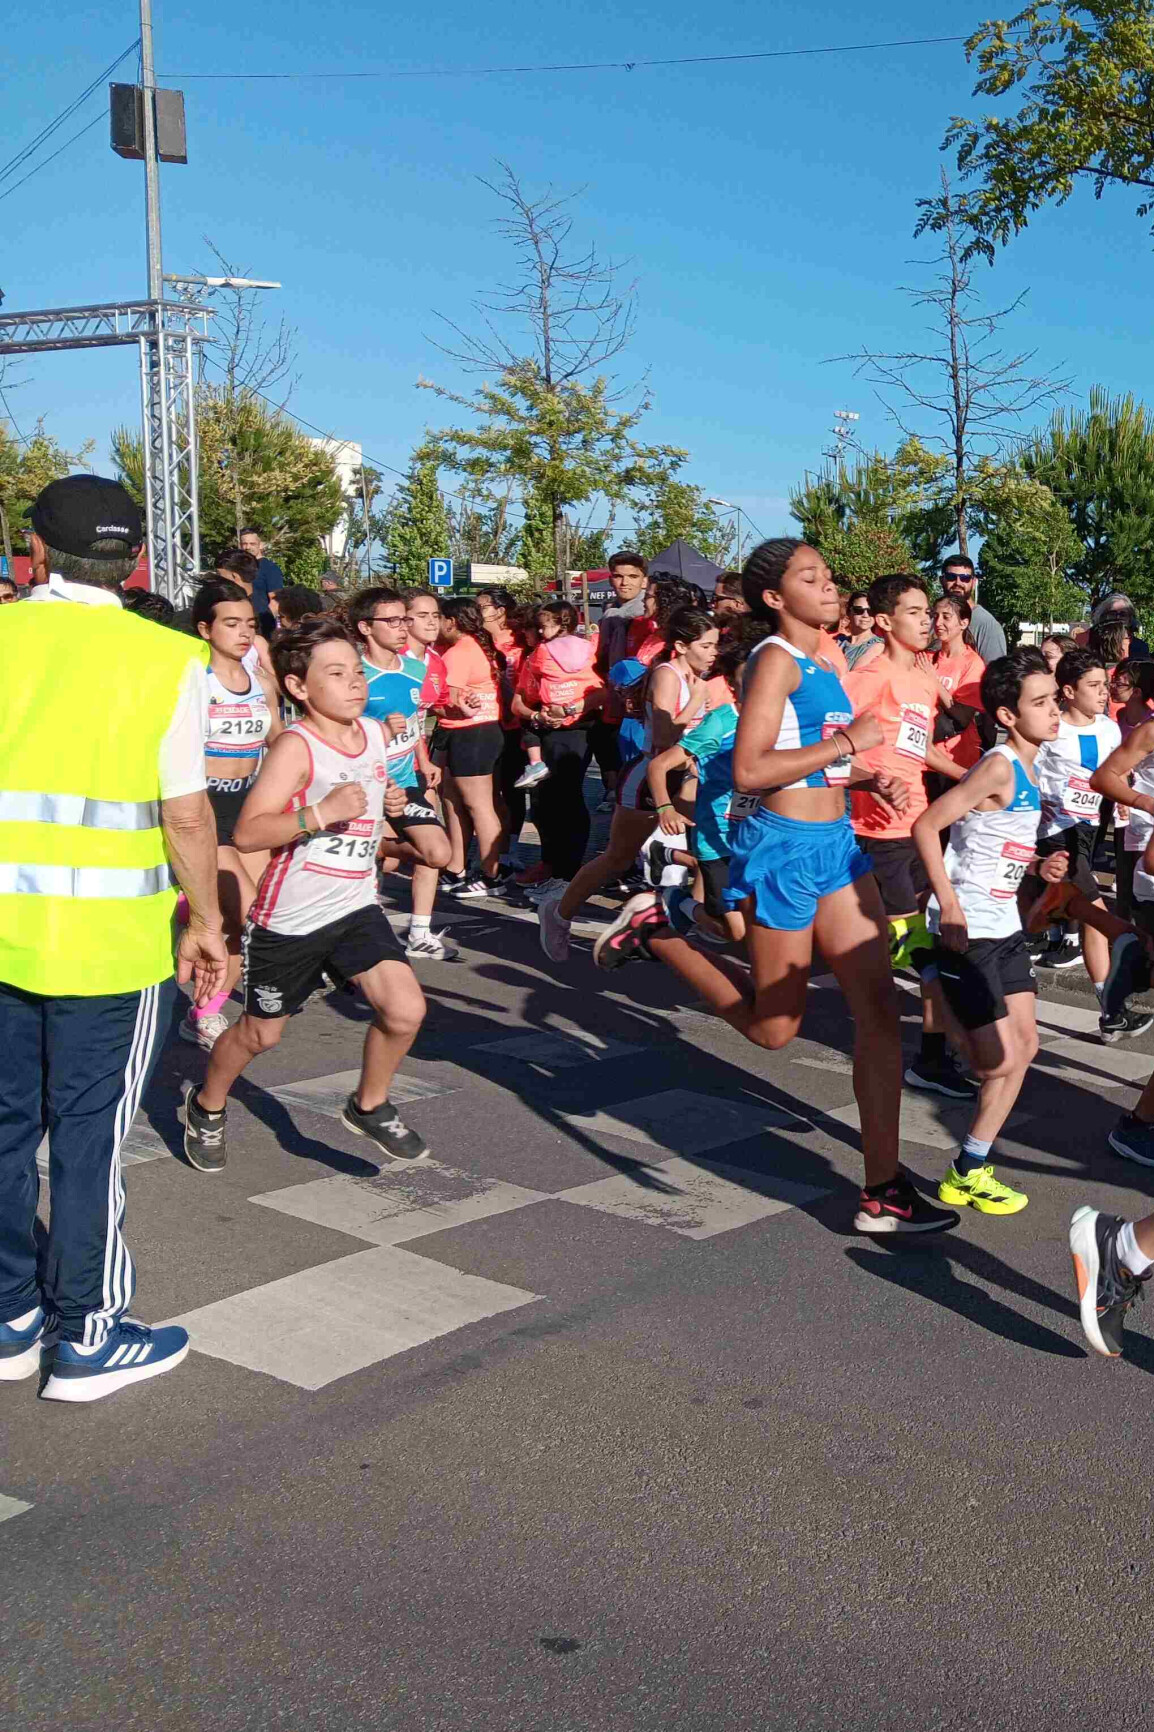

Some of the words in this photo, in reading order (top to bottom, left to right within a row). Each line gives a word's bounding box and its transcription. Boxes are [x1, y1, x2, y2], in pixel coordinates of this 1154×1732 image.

[434, 561, 448, 583] P
[220, 719, 264, 735] 2128
[388, 727, 415, 748] 164
[907, 727, 928, 747] 207
[208, 777, 242, 792] PRO
[1003, 862, 1027, 880] 20
